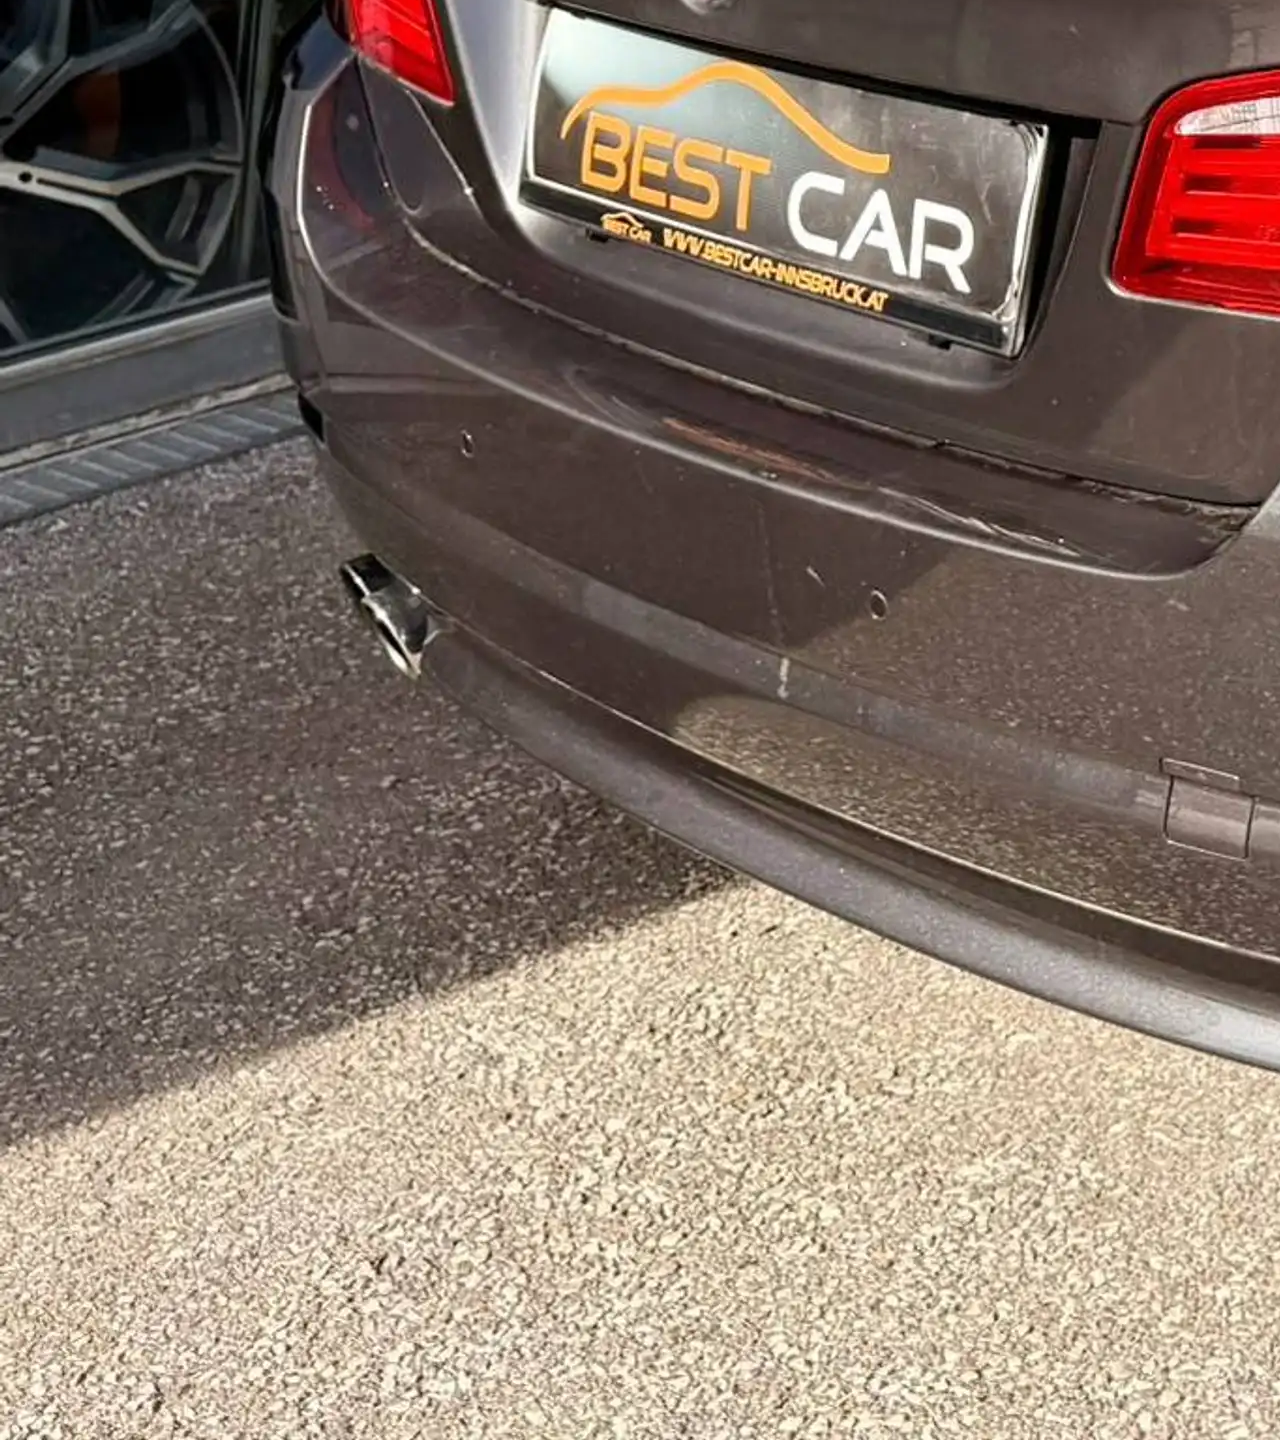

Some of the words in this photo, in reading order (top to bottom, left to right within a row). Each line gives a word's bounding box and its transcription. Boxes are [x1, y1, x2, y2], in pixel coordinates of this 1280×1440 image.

[580, 110, 773, 231] BEST
[787, 171, 975, 294] CAR
[602, 218, 630, 236] BEST
[629, 227, 652, 245] CAR
